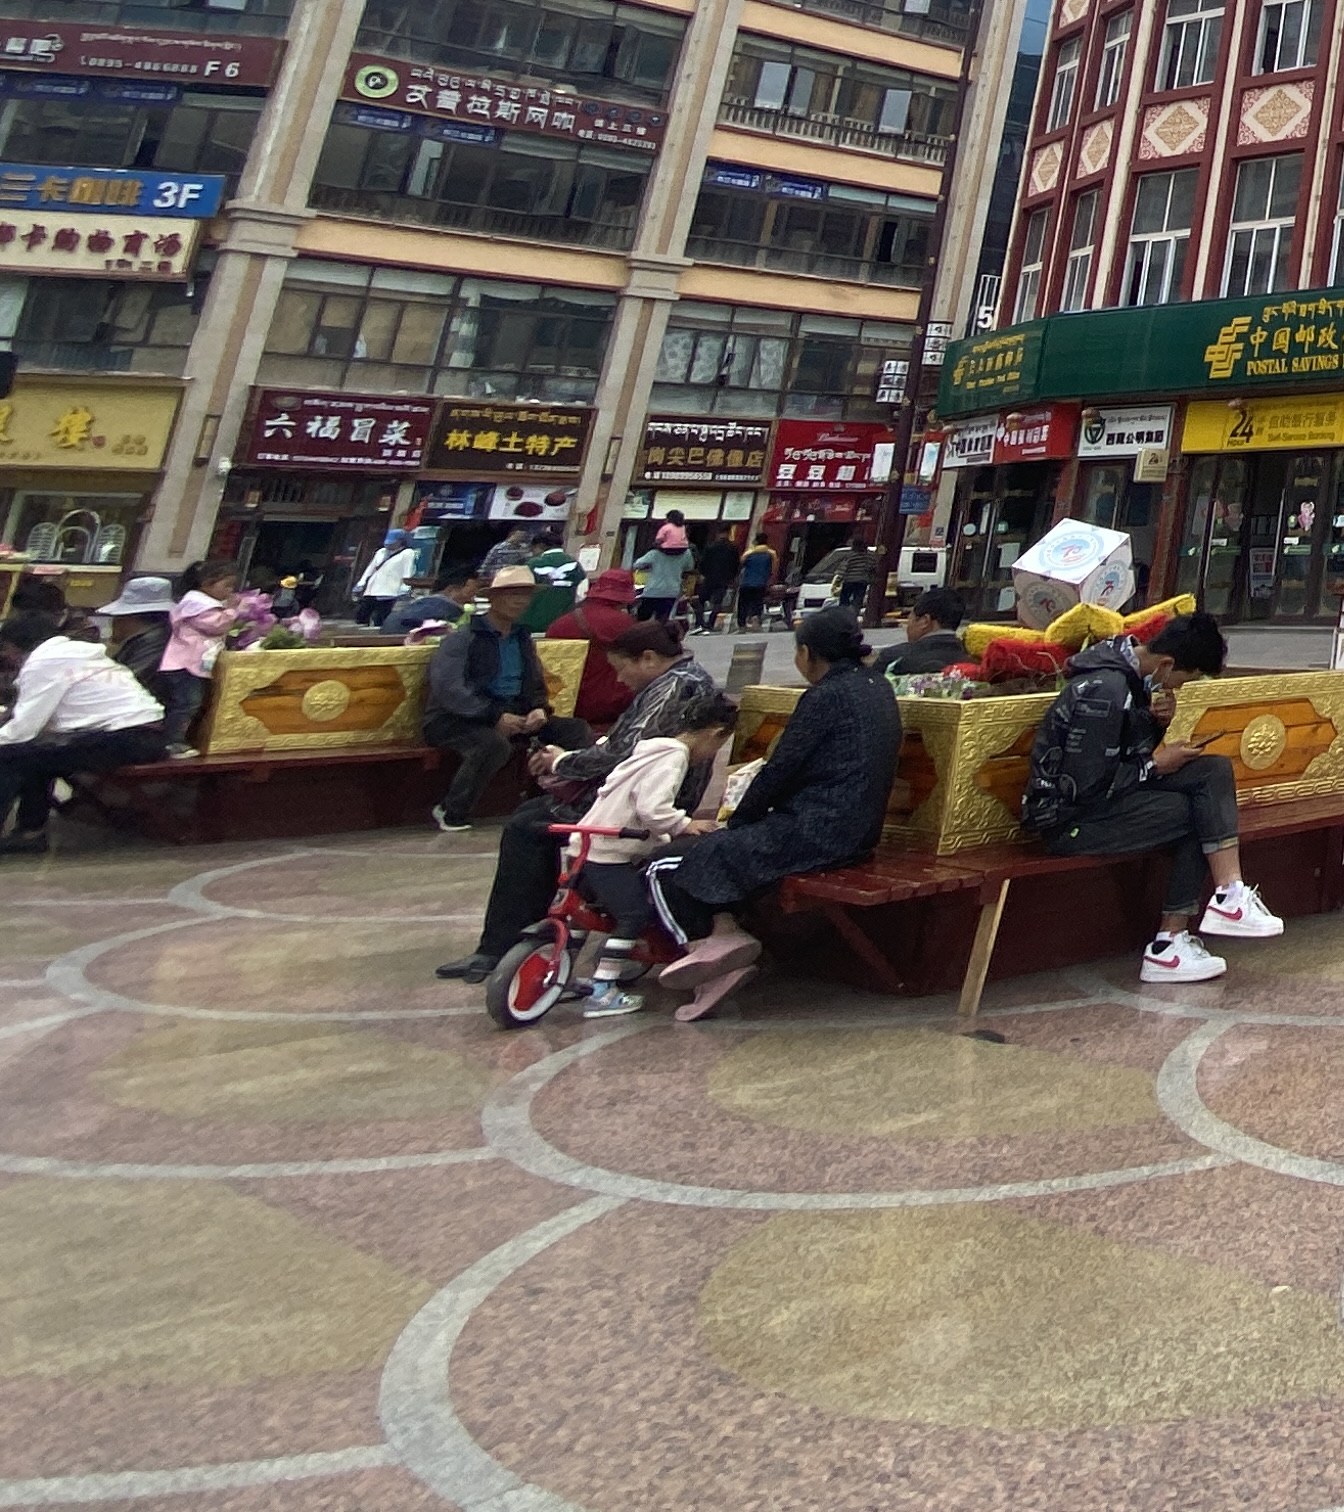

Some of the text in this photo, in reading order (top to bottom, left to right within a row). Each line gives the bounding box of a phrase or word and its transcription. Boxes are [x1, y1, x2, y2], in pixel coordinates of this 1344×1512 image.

[152, 180, 204, 209] 3F
[1246, 358, 1289, 376] POSTAL
[1291, 353, 1339, 373] SAVINGS
[264, 412, 411, 445] 六福冒菜
[1229, 406, 1255, 443] 24
